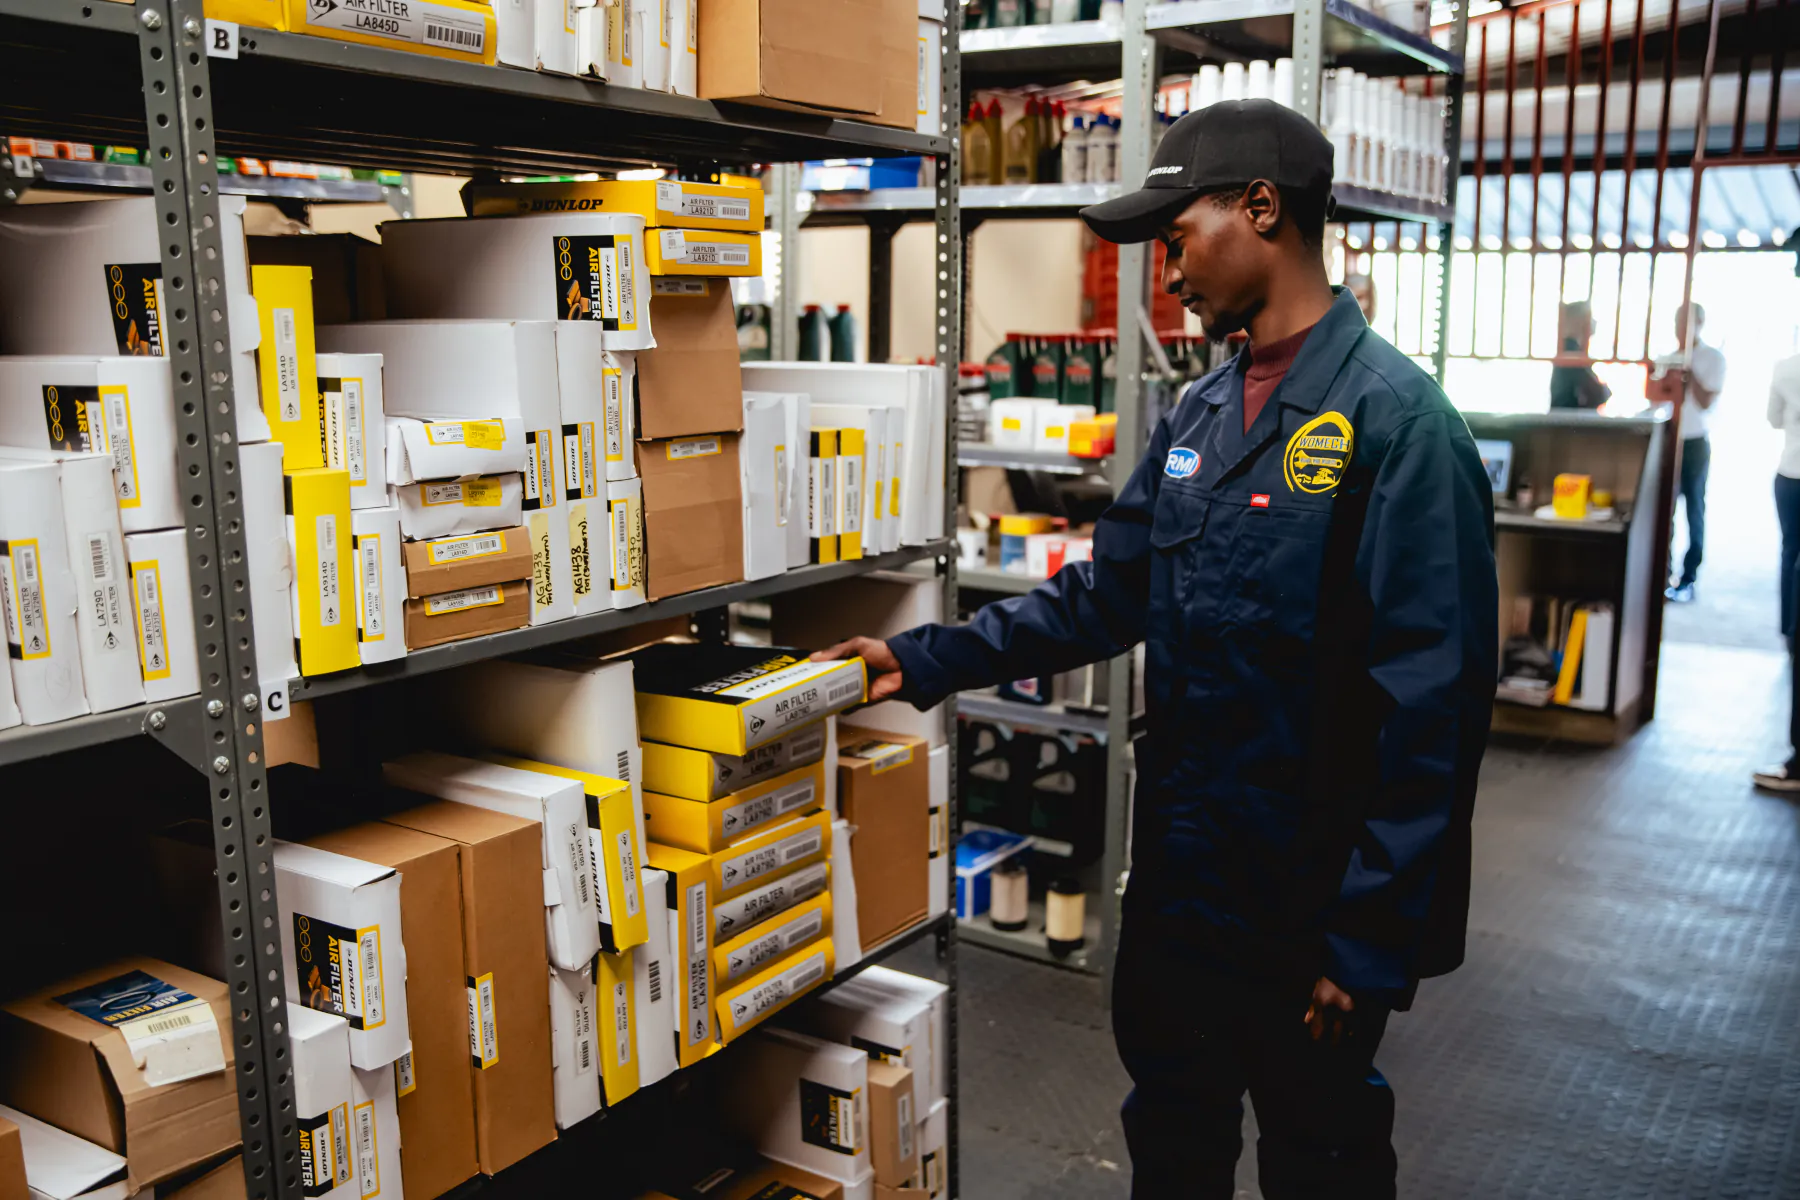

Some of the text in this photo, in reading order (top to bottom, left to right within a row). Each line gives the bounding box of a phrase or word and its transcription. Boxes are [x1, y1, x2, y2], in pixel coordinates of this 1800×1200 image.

[369, 0, 409, 18] FILTER
[356, 14, 400, 33] LA845D
[214, 28, 230, 50] B
[531, 199, 603, 211] DUNLOP
[691, 206, 714, 215] LA921D
[693, 254, 716, 262] LA921D
[588, 247, 602, 319] AIRFILTER
[142, 278, 162, 356] AIRFILTE
[280, 355, 288, 392] LA914D
[1300, 437, 1350, 450] WOMECH
[1166, 456, 1197, 473] RMI
[321, 561, 329, 598] LA914D
[534, 552, 546, 605] AG1438
[571, 545, 584, 594] AG1438
[21, 587, 31, 612] FILTER
[32, 591, 41, 618] LA729D
[94, 590, 108, 627] LA729D
[108, 586, 119, 614] FILTER
[143, 608, 152, 633] FILTER
[153, 611, 162, 638] LA731D
[692, 655, 797, 693] AIRFILTER
[267, 692, 283, 712] C
[775, 688, 818, 714] AIR FILTER
[745, 848, 775, 866] AIR FILTER
[744, 899, 758, 913] AIR
[758, 886, 784, 906] FILTER
[328, 935, 344, 1012] AIRFILTER
[347, 958, 357, 1009] DUNLOP
[698, 959, 707, 1006] LA979D
[102, 996, 179, 1023] AIR FILTER
[298, 1129, 314, 1187] AIRFILTER
[320, 1139, 328, 1177] DUNLOP
